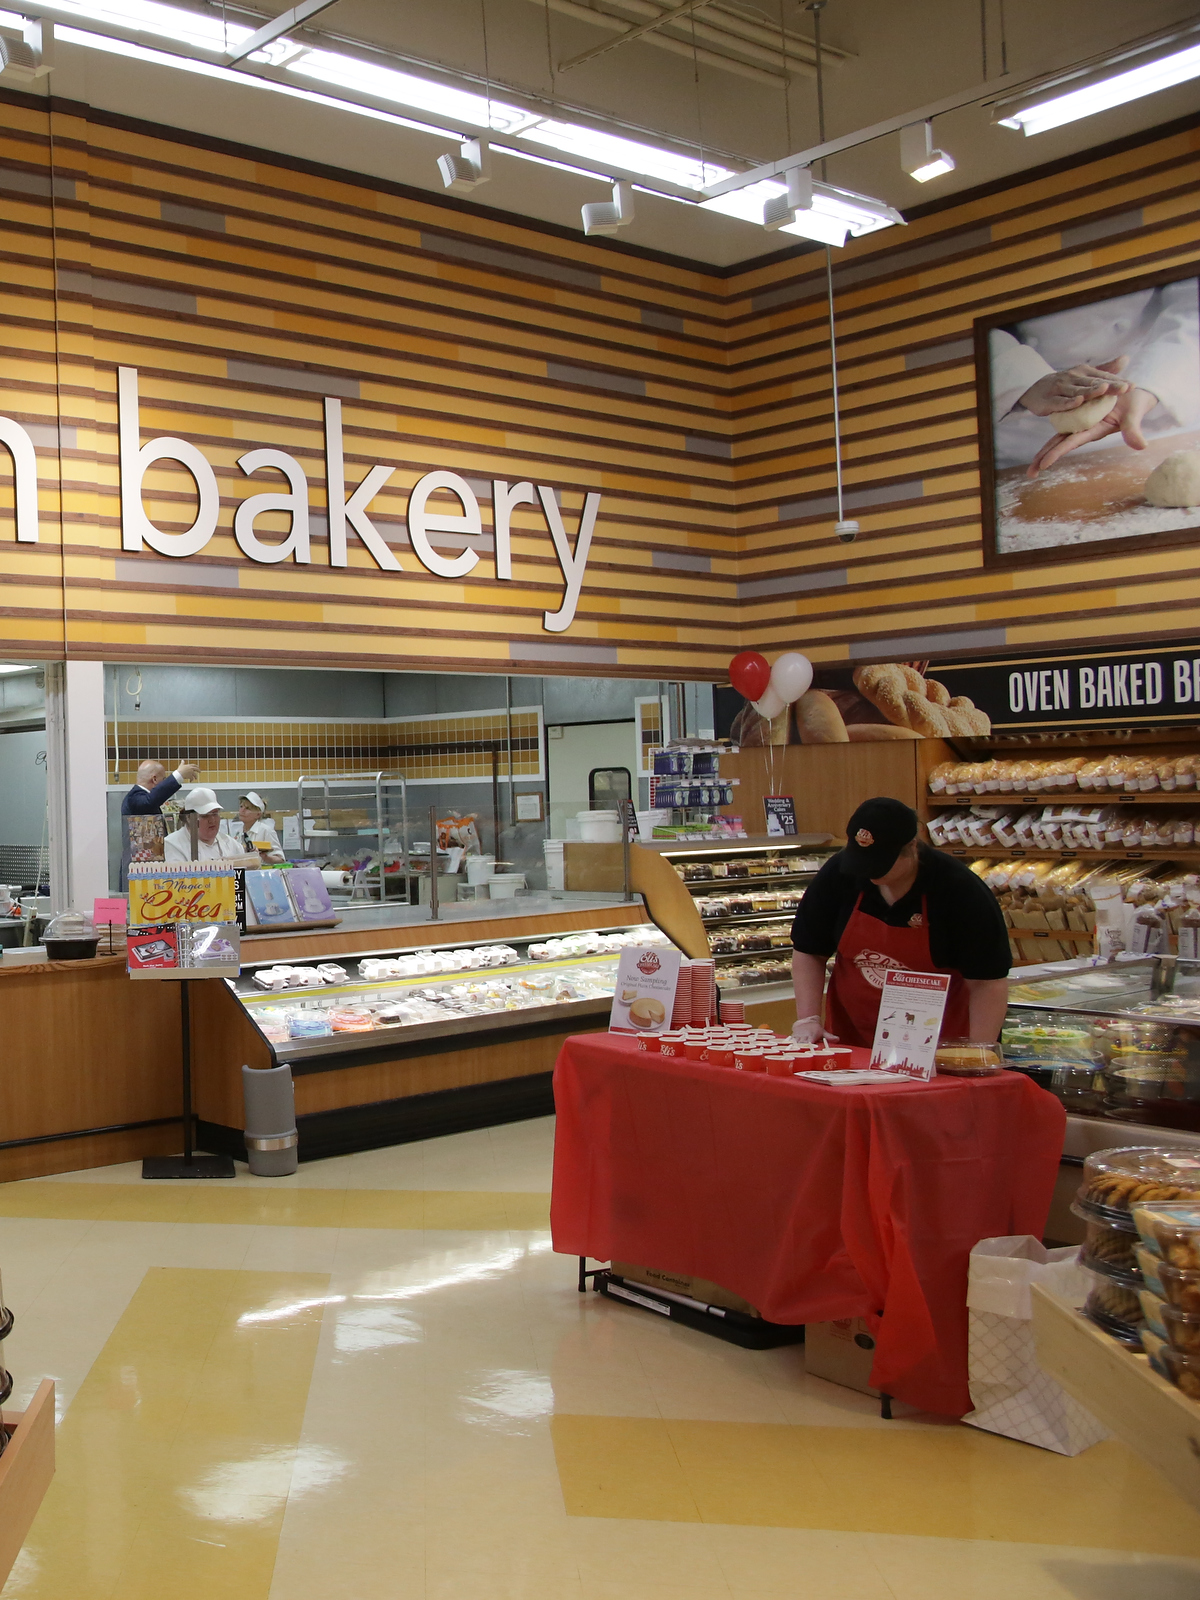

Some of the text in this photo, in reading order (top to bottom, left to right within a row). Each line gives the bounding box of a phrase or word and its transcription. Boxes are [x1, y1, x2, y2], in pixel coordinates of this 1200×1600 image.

[117, 365, 601, 633] bakery
[1008, 669, 1070, 712] OVEN
[1079, 662, 1163, 709] BAKED
[163, 880, 203, 893] Magic
[141, 890, 222, 921] Cakes
[627, 974, 667, 986] Now Sampling
[905, 976, 941, 986] CHEESECAKE
